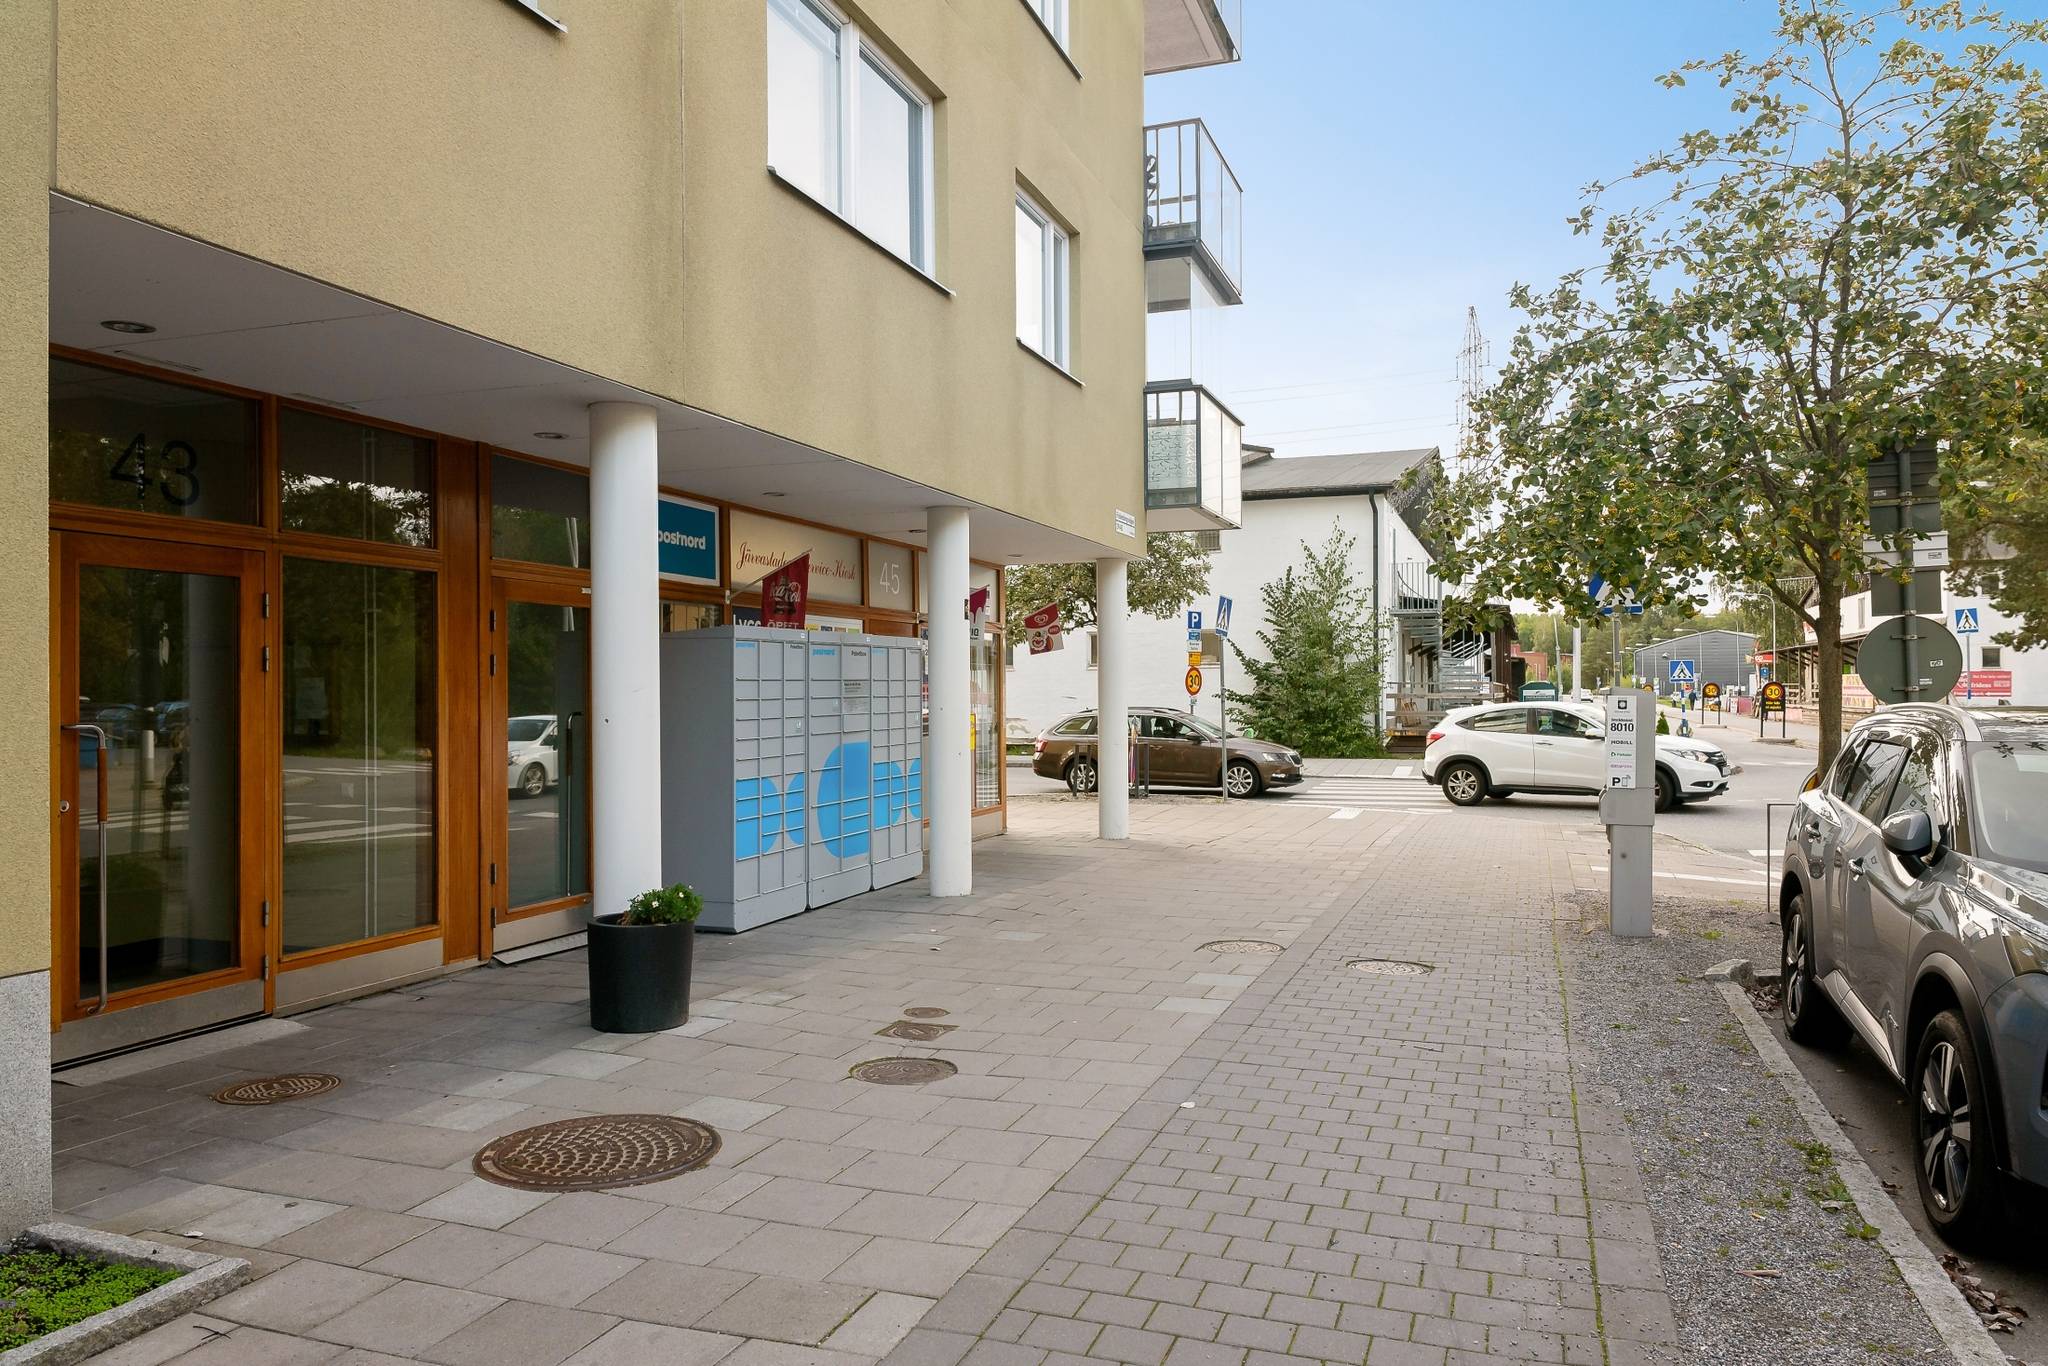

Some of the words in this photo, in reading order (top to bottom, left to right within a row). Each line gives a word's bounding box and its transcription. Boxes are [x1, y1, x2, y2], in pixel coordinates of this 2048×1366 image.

[110, 433, 200, 506] 43
[658, 529, 706, 550] postnord
[879, 562, 900, 595] 45
[1192, 613, 1199, 628] P
[1189, 674, 1200, 688] 30
[1767, 688, 1780, 696] 30
[1610, 722, 1634, 732] 8010
[1612, 777, 1621, 786] P
